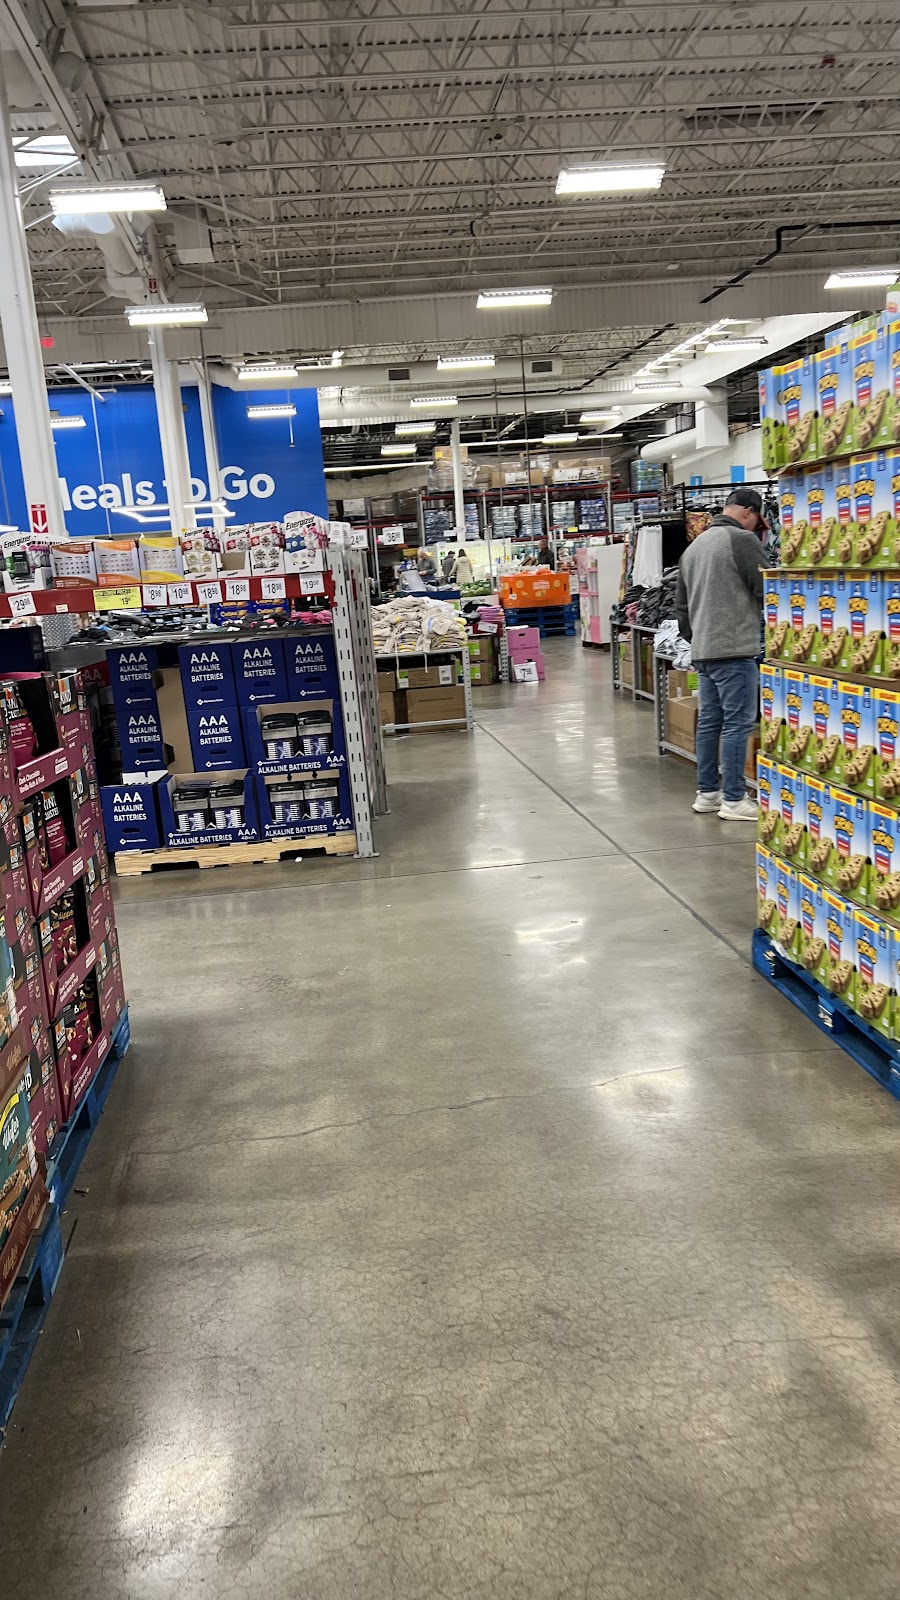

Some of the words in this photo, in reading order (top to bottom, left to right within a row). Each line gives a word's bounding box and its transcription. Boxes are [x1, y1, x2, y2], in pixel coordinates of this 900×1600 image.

[219, 466, 276, 500] Go
[285, 516, 315, 531] Energizer
[3, 536, 31, 549] Energizer
[243, 647, 272, 660] AAA
[295, 642, 324, 655] AAA
[119, 652, 147, 664] AAA
[190, 651, 219, 663] AAA
[295, 655, 325, 664] ALKALINE
[119, 663, 148, 672] ALKALINE
[191, 663, 221, 673] ALKALINE
[243, 658, 273, 668] ALKALINE
[295, 663, 328, 673] BATTERIES
[120, 672, 151, 682] BATTERIES
[191, 672, 224, 682] BATTERIES
[243, 667, 277, 678] BATTERIES
[128, 714, 157, 726] AAA
[199, 715, 228, 727] AAA
[128, 725, 158, 735] ALKALINE
[199, 726, 230, 736] ALKALINE
[129, 734, 161, 744] BATTERIES
[200, 735, 233, 745] BATTERIES
[326, 754, 346, 764] AAA
[258, 764, 289, 775] ALKALINE
[288, 761, 322, 772] BATTERIES
[113, 791, 142, 804] AAA
[113, 803, 144, 812] ALKALINE
[114, 812, 147, 822] BATTERIES
[332, 817, 352, 827] AAA
[237, 828, 258, 836] AAA
[265, 827, 296, 837] ALKALINE
[295, 824, 328, 835] BATTERIES
[169, 836, 200, 846] ALKALINE
[200, 834, 233, 843] BATTERIES
